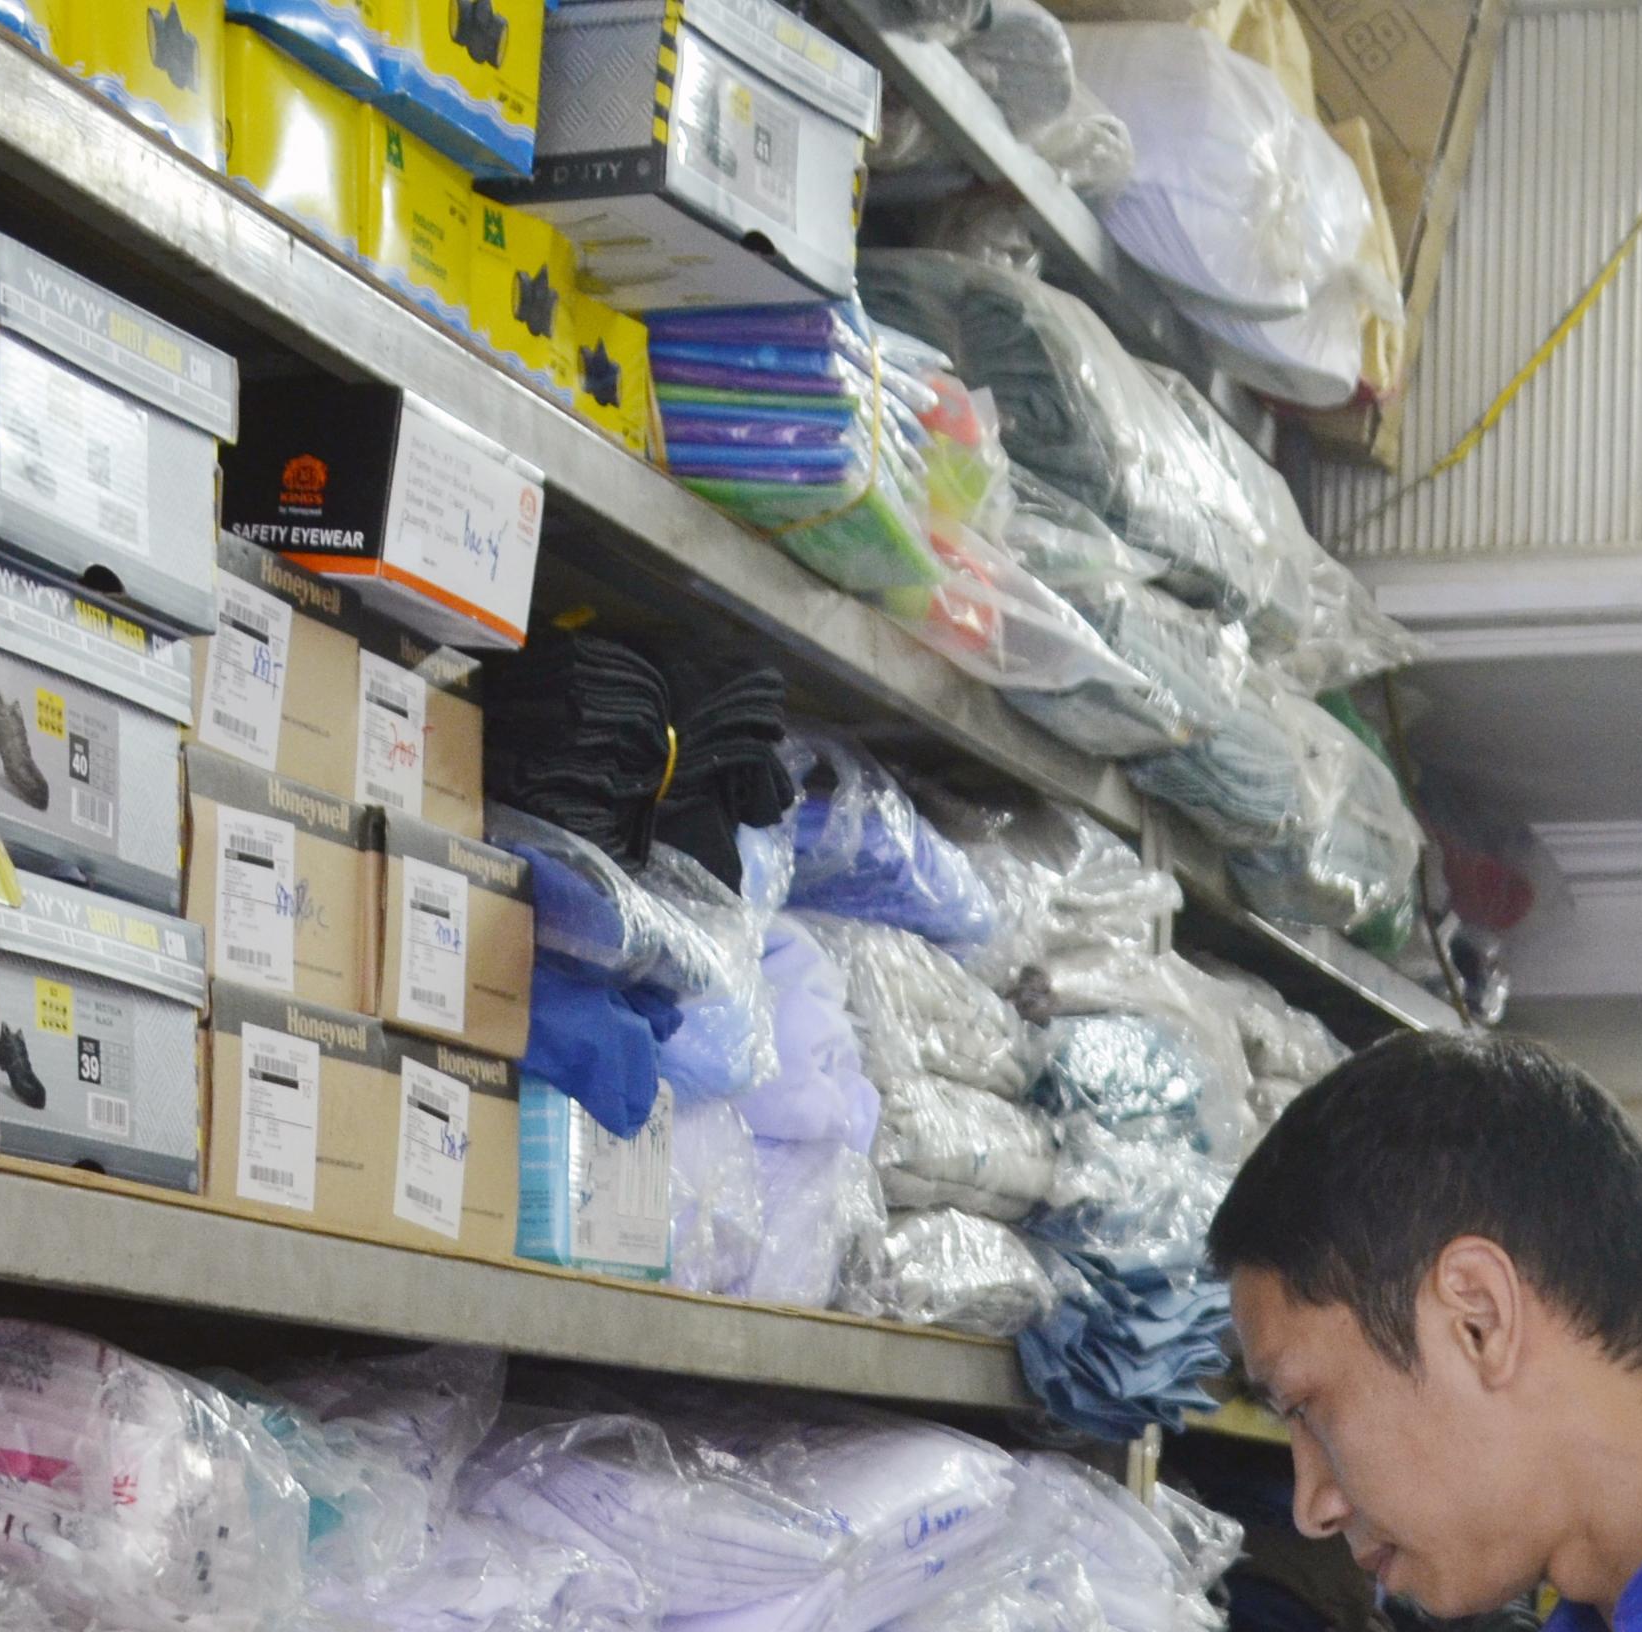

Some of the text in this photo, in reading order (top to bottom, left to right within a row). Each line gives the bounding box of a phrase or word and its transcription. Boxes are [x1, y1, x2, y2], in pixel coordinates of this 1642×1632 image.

[232, 522, 365, 550] SAFETY EYEWEAR
[260, 555, 342, 617] Honeywell
[72, 753, 88, 777] 40
[268, 776, 350, 832] Honeywell
[448, 837, 519, 888] Honeywell
[286, 1006, 368, 1052] Honeywell
[80, 1053, 100, 1081] 39
[436, 1046, 508, 1085] Honeywell
